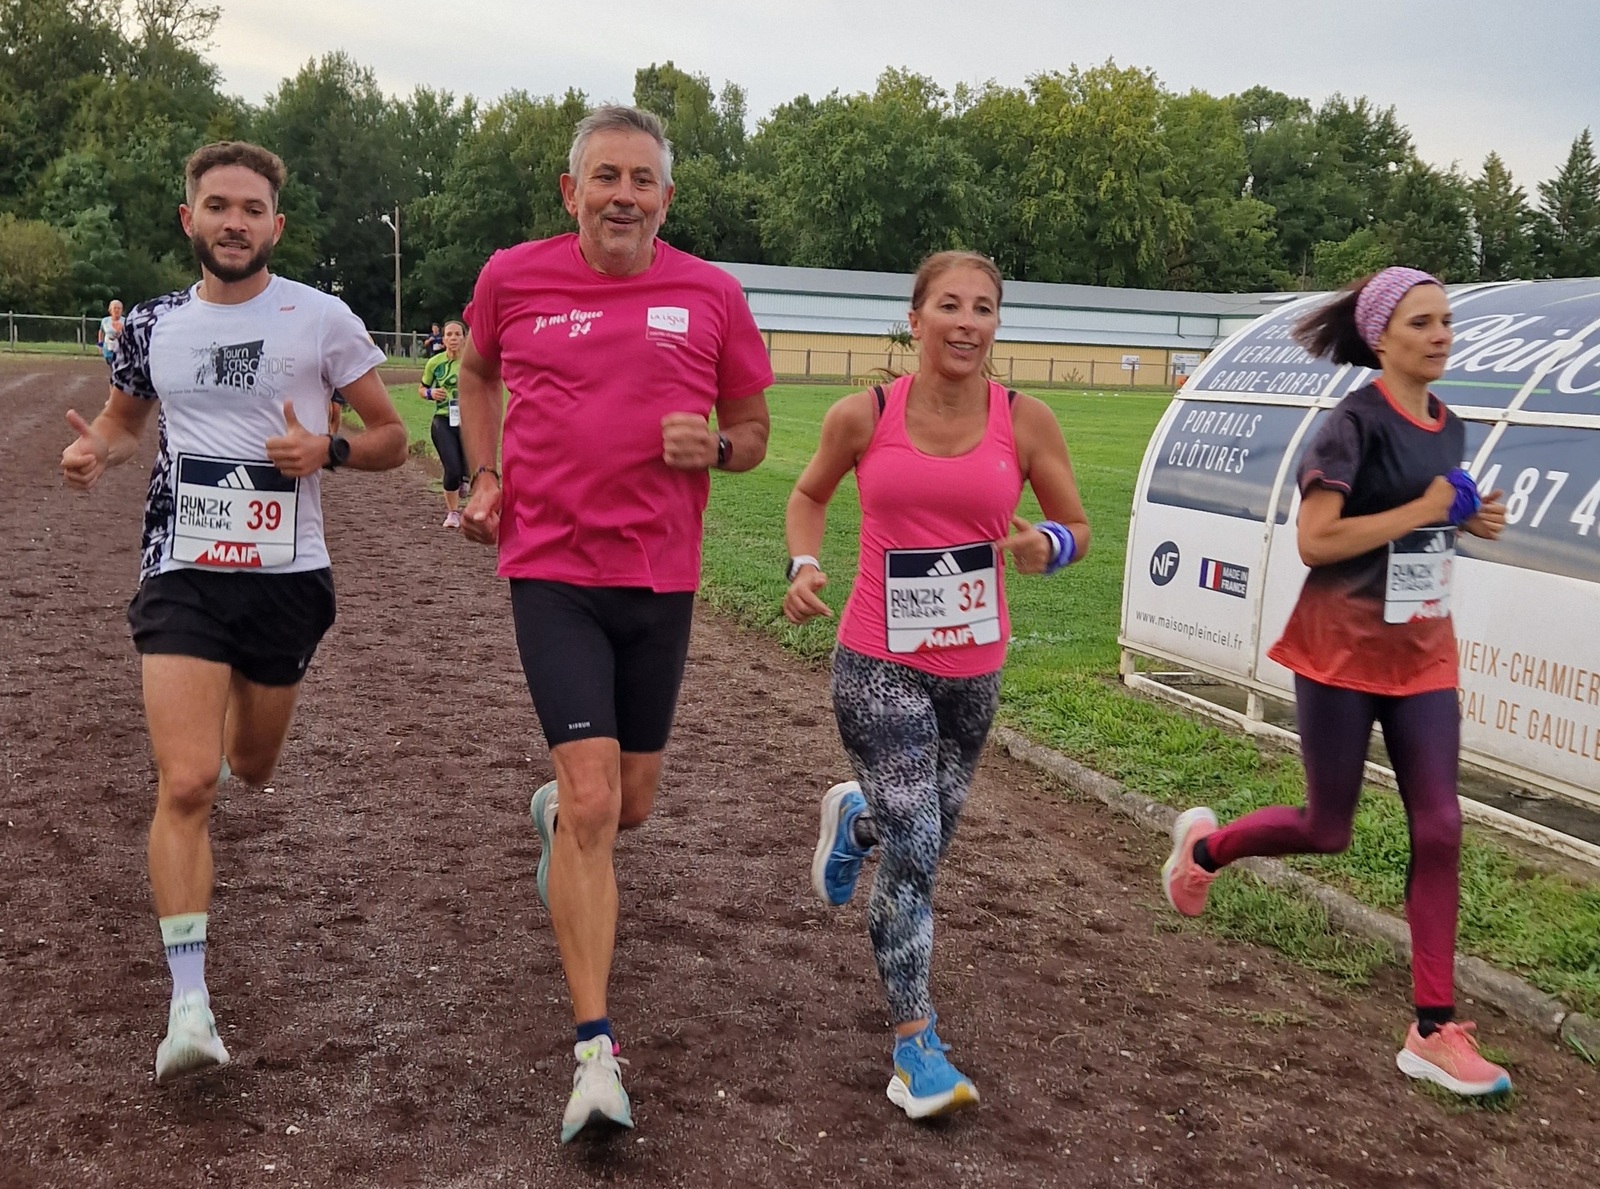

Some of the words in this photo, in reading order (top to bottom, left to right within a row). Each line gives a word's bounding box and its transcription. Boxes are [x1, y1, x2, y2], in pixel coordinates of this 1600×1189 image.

[532, 316, 548, 335] Je
[549, 313, 567, 326] me
[570, 309, 604, 323] ligue
[568, 321, 592, 338] 24
[1208, 370, 1331, 395] GARDE-CORPS
[1181, 409, 1262, 438] PORTAILS
[1168, 438, 1249, 474] CLÔTURES
[180, 494, 232, 517] RUN2K
[247, 500, 282, 530] 39
[207, 545, 258, 563] MAIF
[1152, 551, 1178, 578] NF
[1222, 566, 1241, 580] MADE
[1240, 571, 1248, 582] IN
[891, 587, 946, 609] RUN2K
[958, 578, 987, 612] 32
[1221, 579, 1247, 595] FRANCE
[925, 628, 973, 649] MAIF
[1135, 609, 1243, 650] www.maisonpleinciel.fr
[1496, 699, 1520, 735] DE
